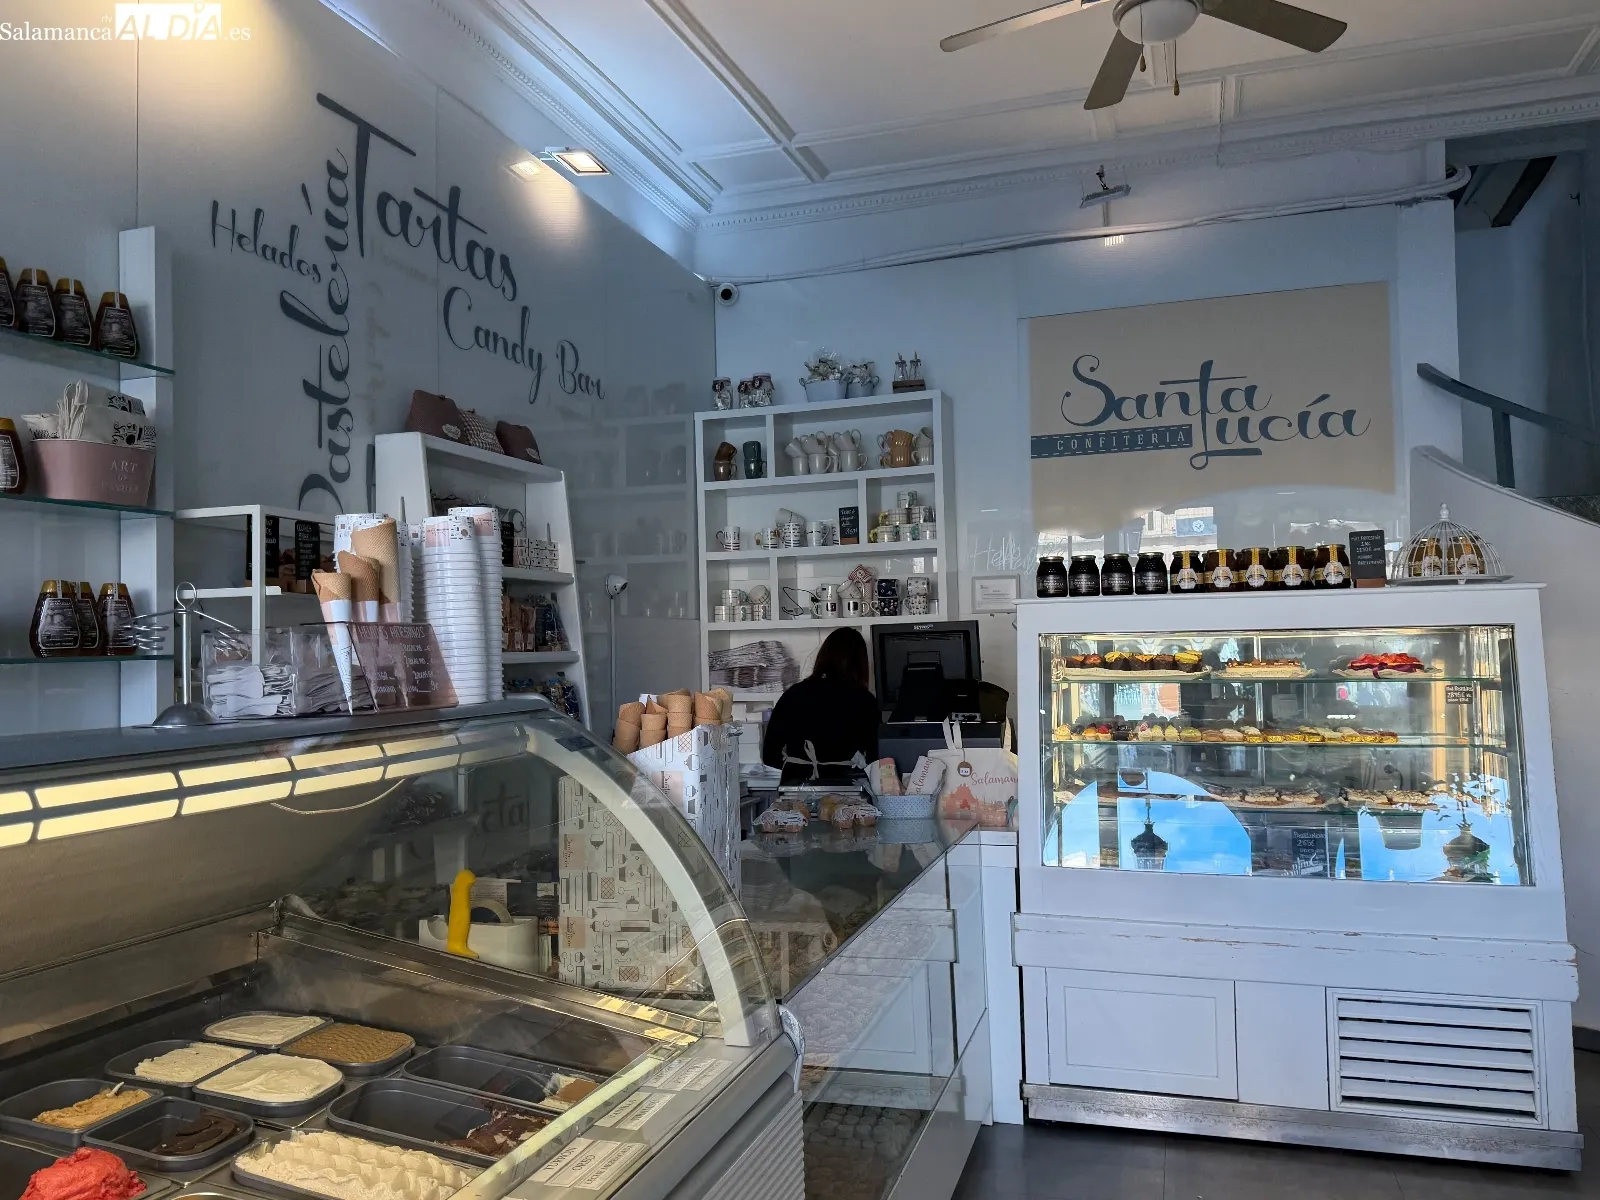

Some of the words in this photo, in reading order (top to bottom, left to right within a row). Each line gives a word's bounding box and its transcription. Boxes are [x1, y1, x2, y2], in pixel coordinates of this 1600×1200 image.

[211, 199, 322, 285] Helados
[316, 92, 519, 302] Tartas
[443, 286, 548, 405] Candy
[555, 339, 606, 400] Bar
[1056, 430, 1187, 451] CONFITERIA
[1061, 354, 1272, 430] Santa
[1189, 393, 1371, 470] Lucía
[109, 459, 138, 474] ART
